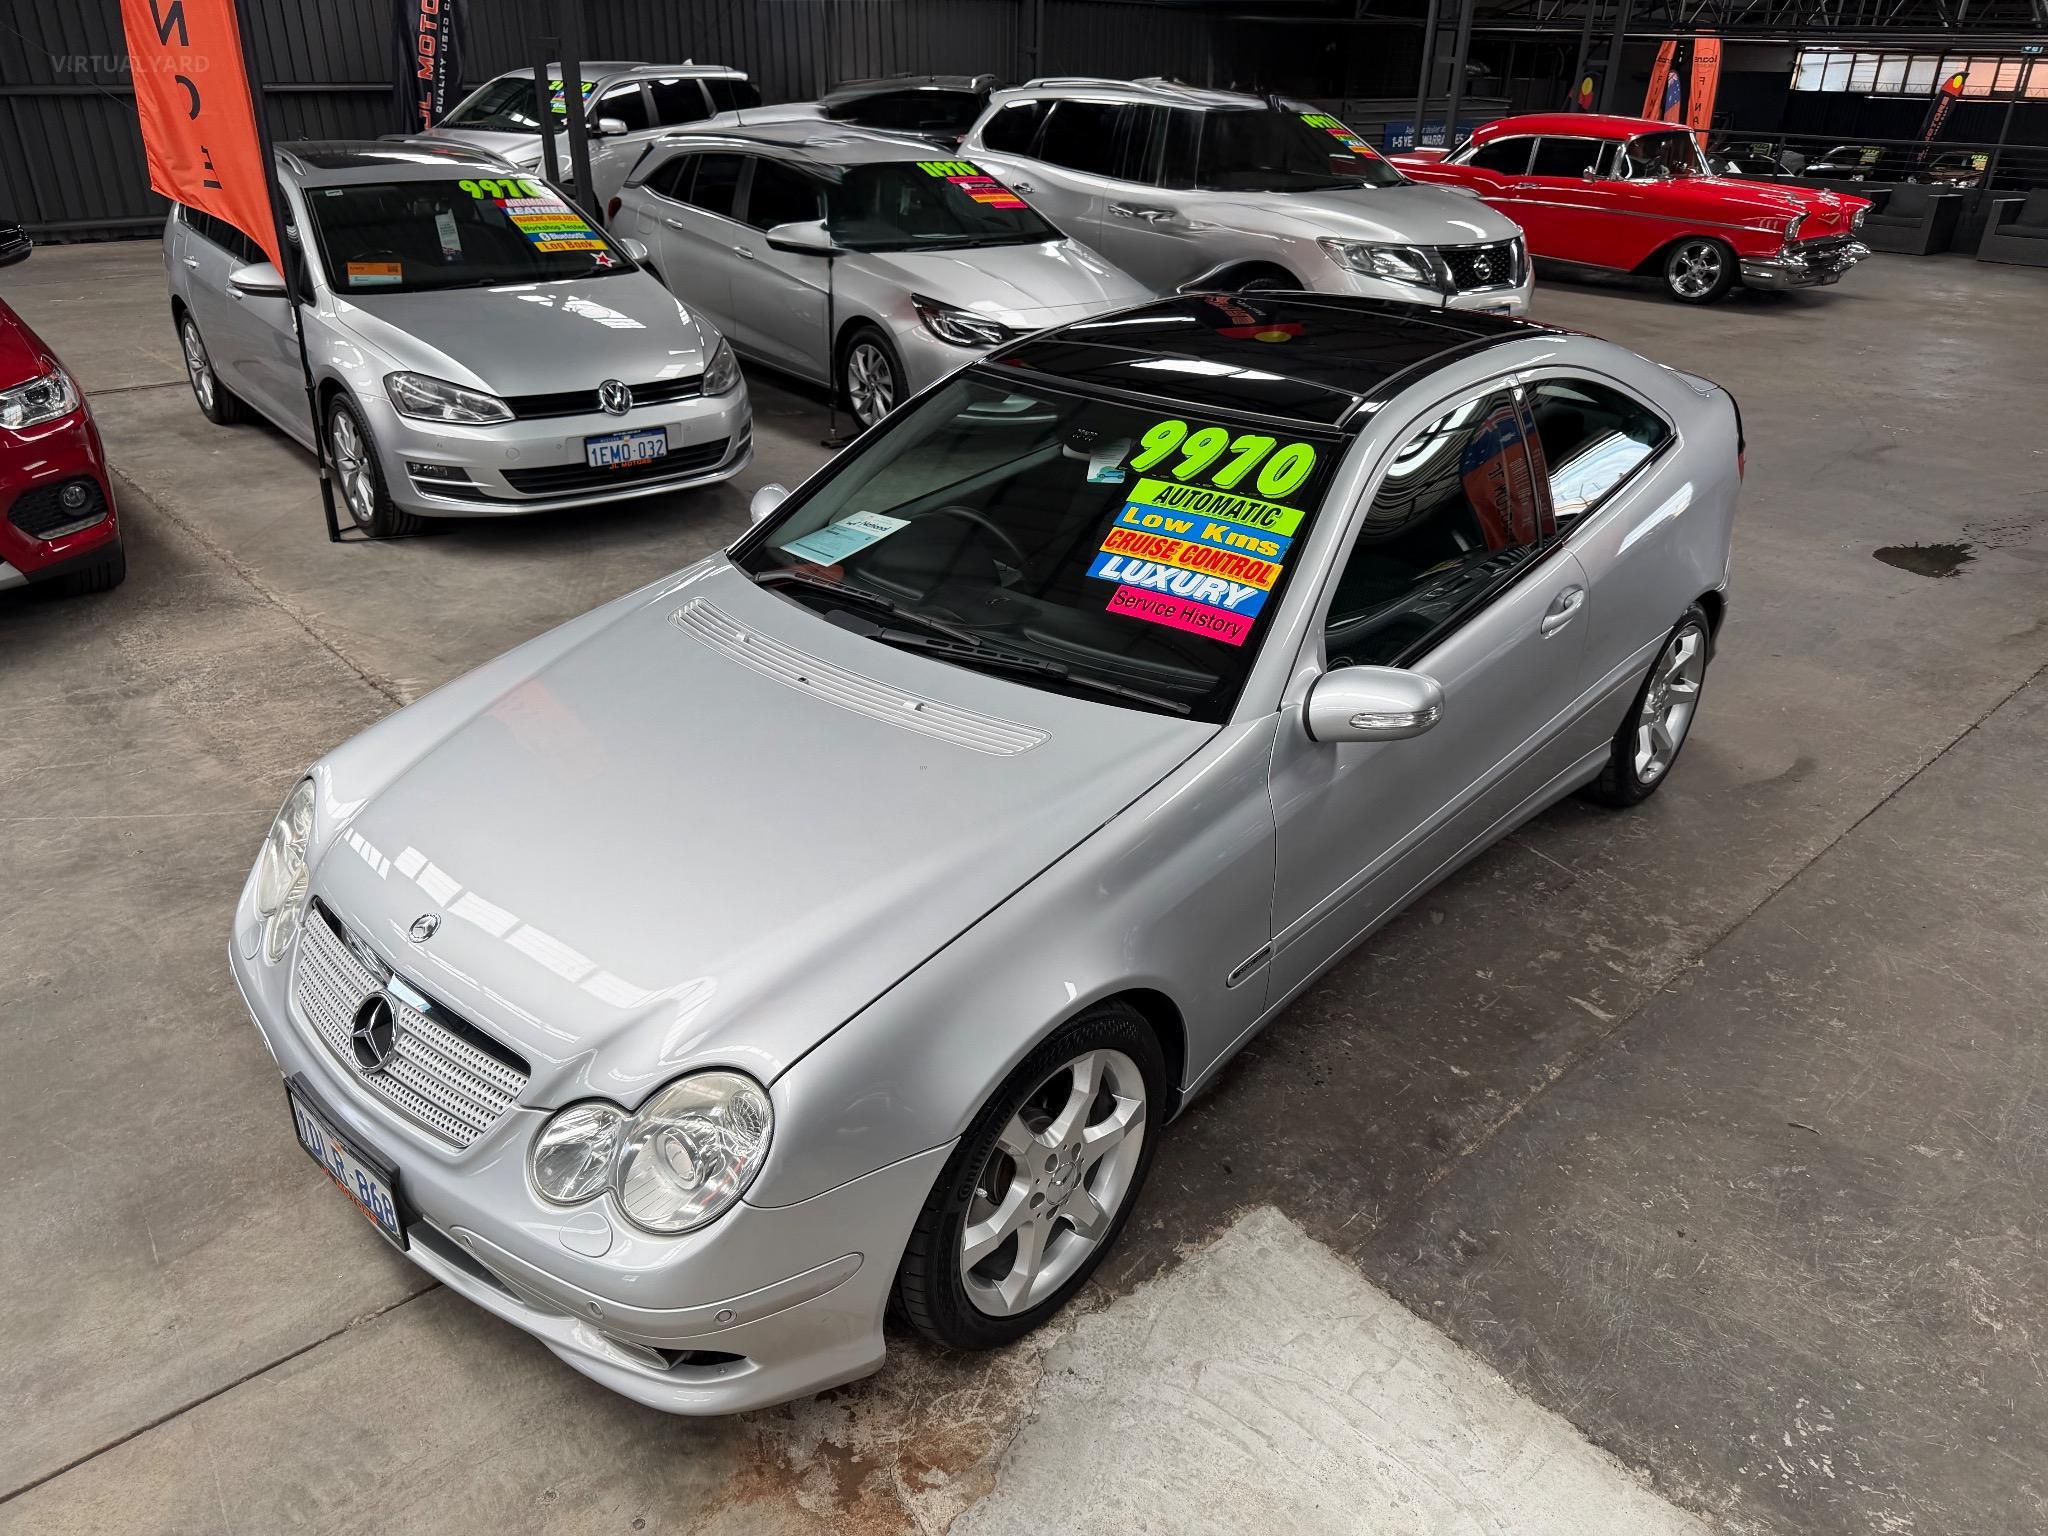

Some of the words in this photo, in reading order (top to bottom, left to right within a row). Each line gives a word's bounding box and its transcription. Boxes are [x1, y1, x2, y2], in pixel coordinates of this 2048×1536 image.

[441, 17, 450, 52] USED
[436, 58, 447, 114] QUALITY
[458, 179, 543, 200] 9970
[544, 242, 566, 251] Log
[568, 241, 595, 249] Book
[1129, 420, 1317, 498] 9970
[1122, 506, 1194, 534] Low
[1201, 522, 1281, 557] Kms
[1152, 485, 1284, 527] AUTOMATIC
[1098, 555, 1260, 608] LUXURY
[1104, 529, 1182, 561] CRUISE
[1178, 544, 1276, 585] CONTROL
[1113, 589, 1177, 619] Service
[1181, 606, 1245, 642] History
